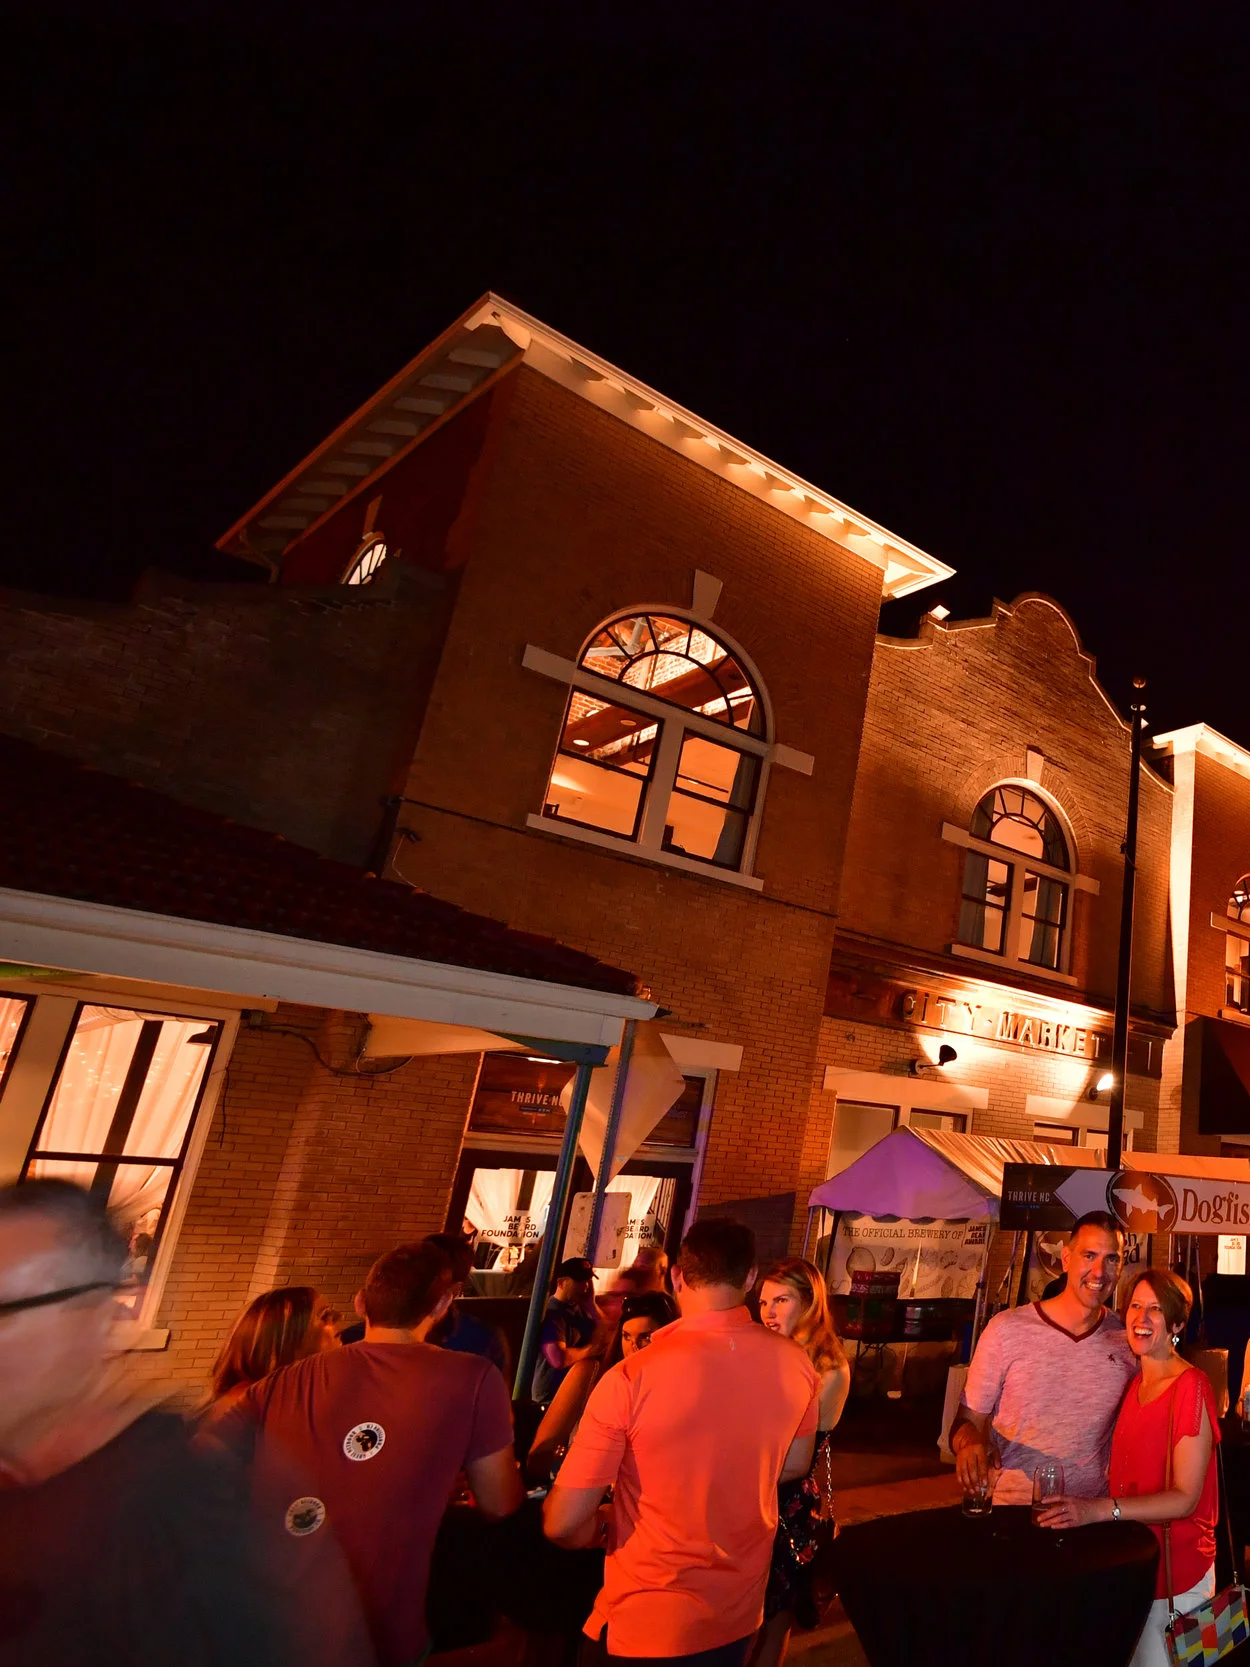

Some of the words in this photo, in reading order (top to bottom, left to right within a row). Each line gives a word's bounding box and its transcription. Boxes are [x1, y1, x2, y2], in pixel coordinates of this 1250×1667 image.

[902, 990, 982, 1034] CITY
[996, 1011, 1106, 1058] MARKET
[511, 1090, 549, 1105] THRIVE
[1007, 1190, 1038, 1202] THRIVE
[1039, 1191, 1050, 1203] NC
[503, 1215, 531, 1223] JAMS
[508, 1223, 536, 1231] BERD
[843, 1226, 860, 1237] THE
[862, 1227, 905, 1238] OFFICIAL
[908, 1228, 951, 1239] BREWERY
[952, 1230, 963, 1240] OF
[481, 1230, 539, 1238] FOUNDAION
